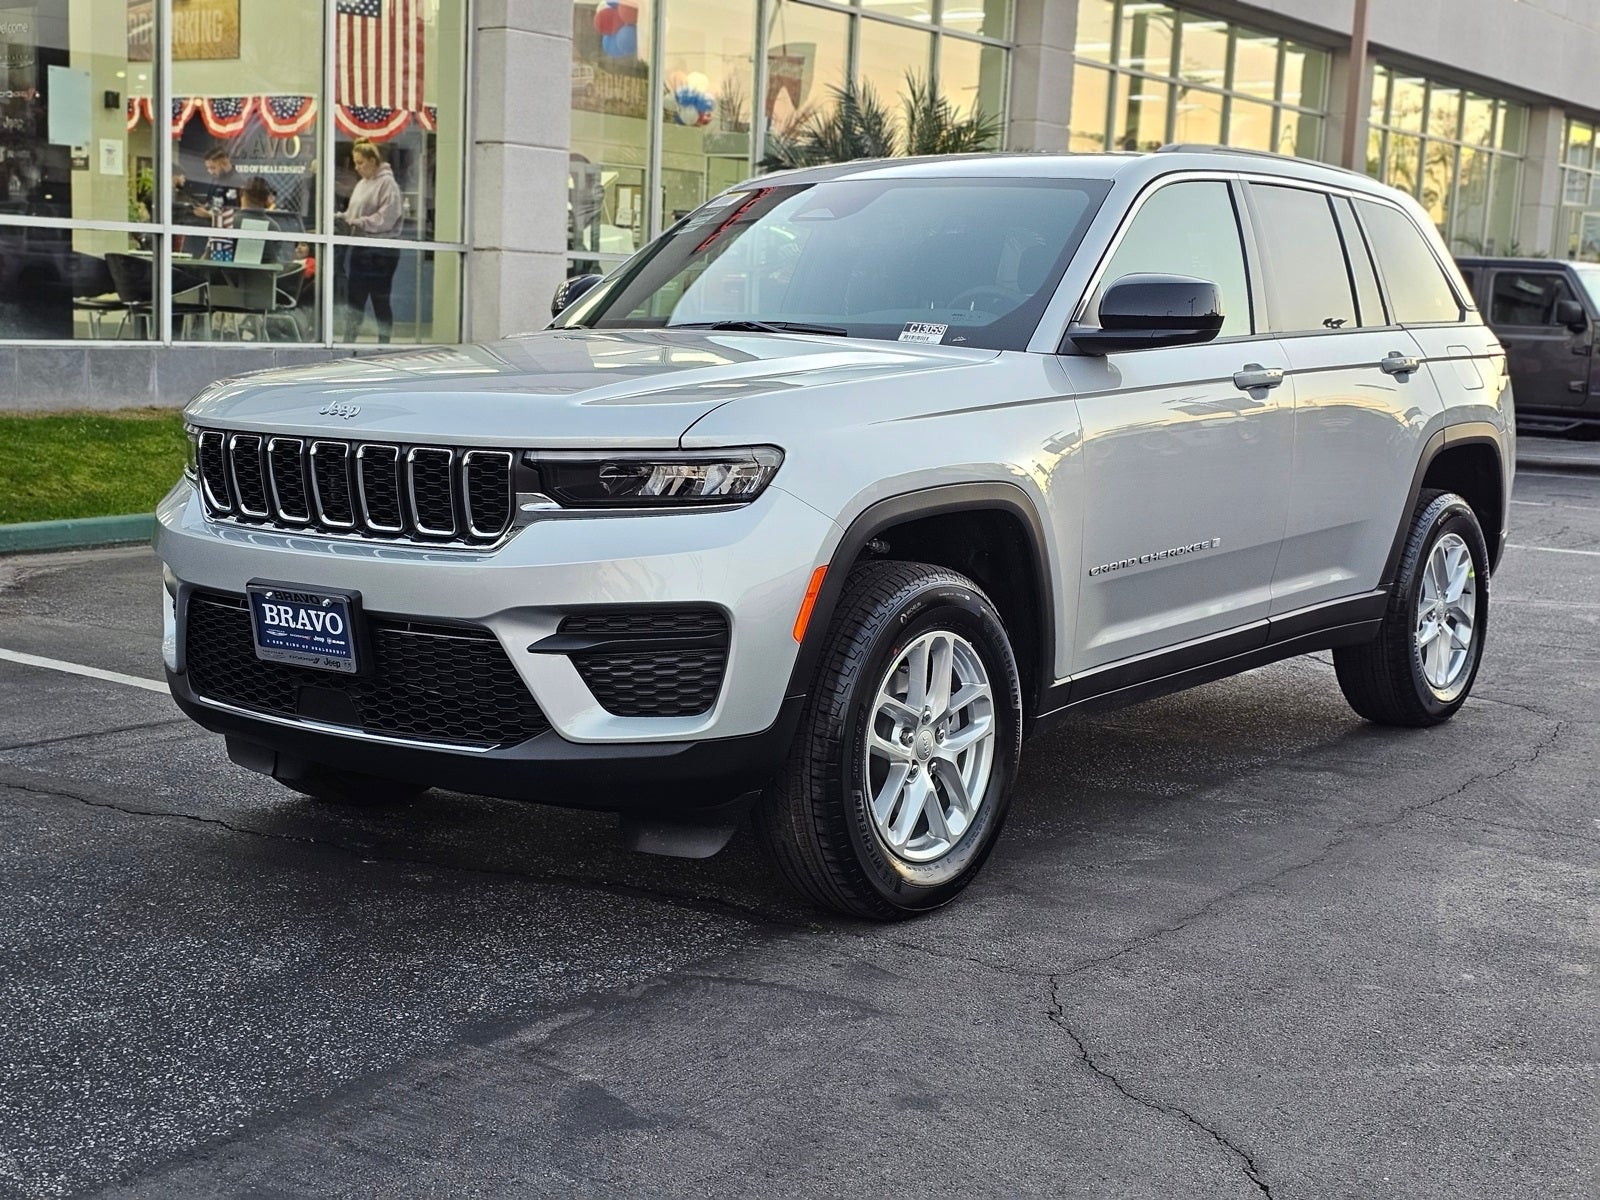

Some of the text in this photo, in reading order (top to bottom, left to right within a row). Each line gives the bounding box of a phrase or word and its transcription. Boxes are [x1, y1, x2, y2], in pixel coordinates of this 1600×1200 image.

[0, 22, 29, 34] elcome
[319, 400, 362, 420] Jeep
[1088, 540, 1210, 577] GRAND CHEROKEE
[275, 591, 320, 604] BRAVO
[262, 603, 344, 635] BRAVO
[323, 657, 341, 668] Jeep
[995, 634, 1020, 707] MICHELIN
[855, 791, 884, 869] MICHELIN
